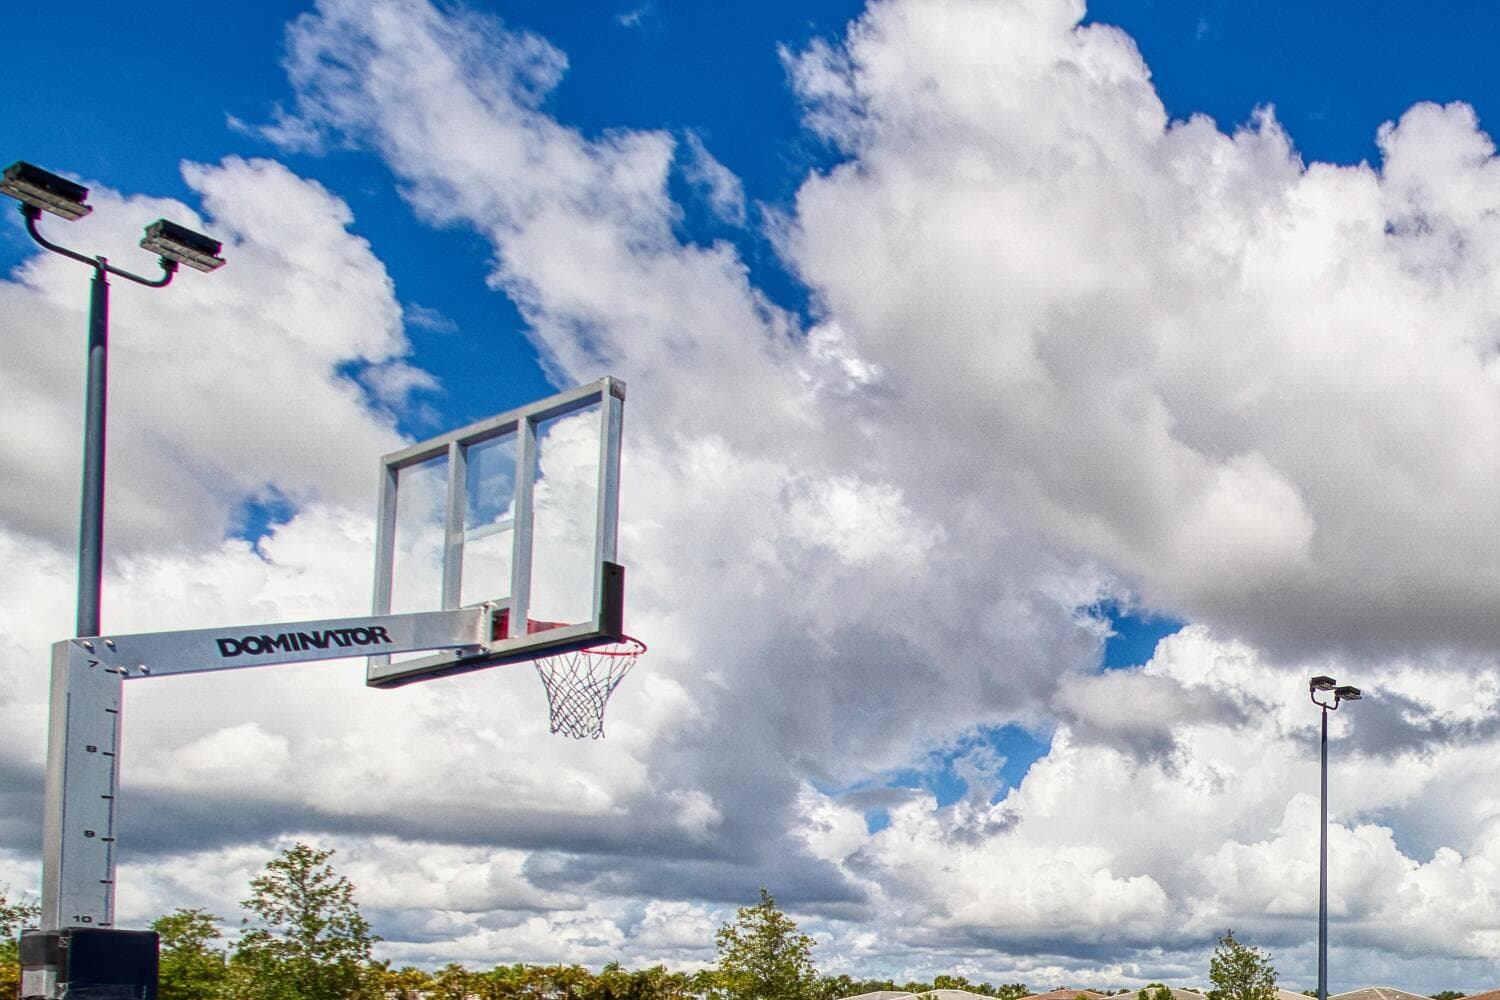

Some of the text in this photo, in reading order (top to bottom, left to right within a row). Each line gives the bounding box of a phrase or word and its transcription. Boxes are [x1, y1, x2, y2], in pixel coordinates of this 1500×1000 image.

[216, 626, 392, 657] DOMINATOR
[84, 830, 95, 838] 9
[72, 915, 92, 923] 10
